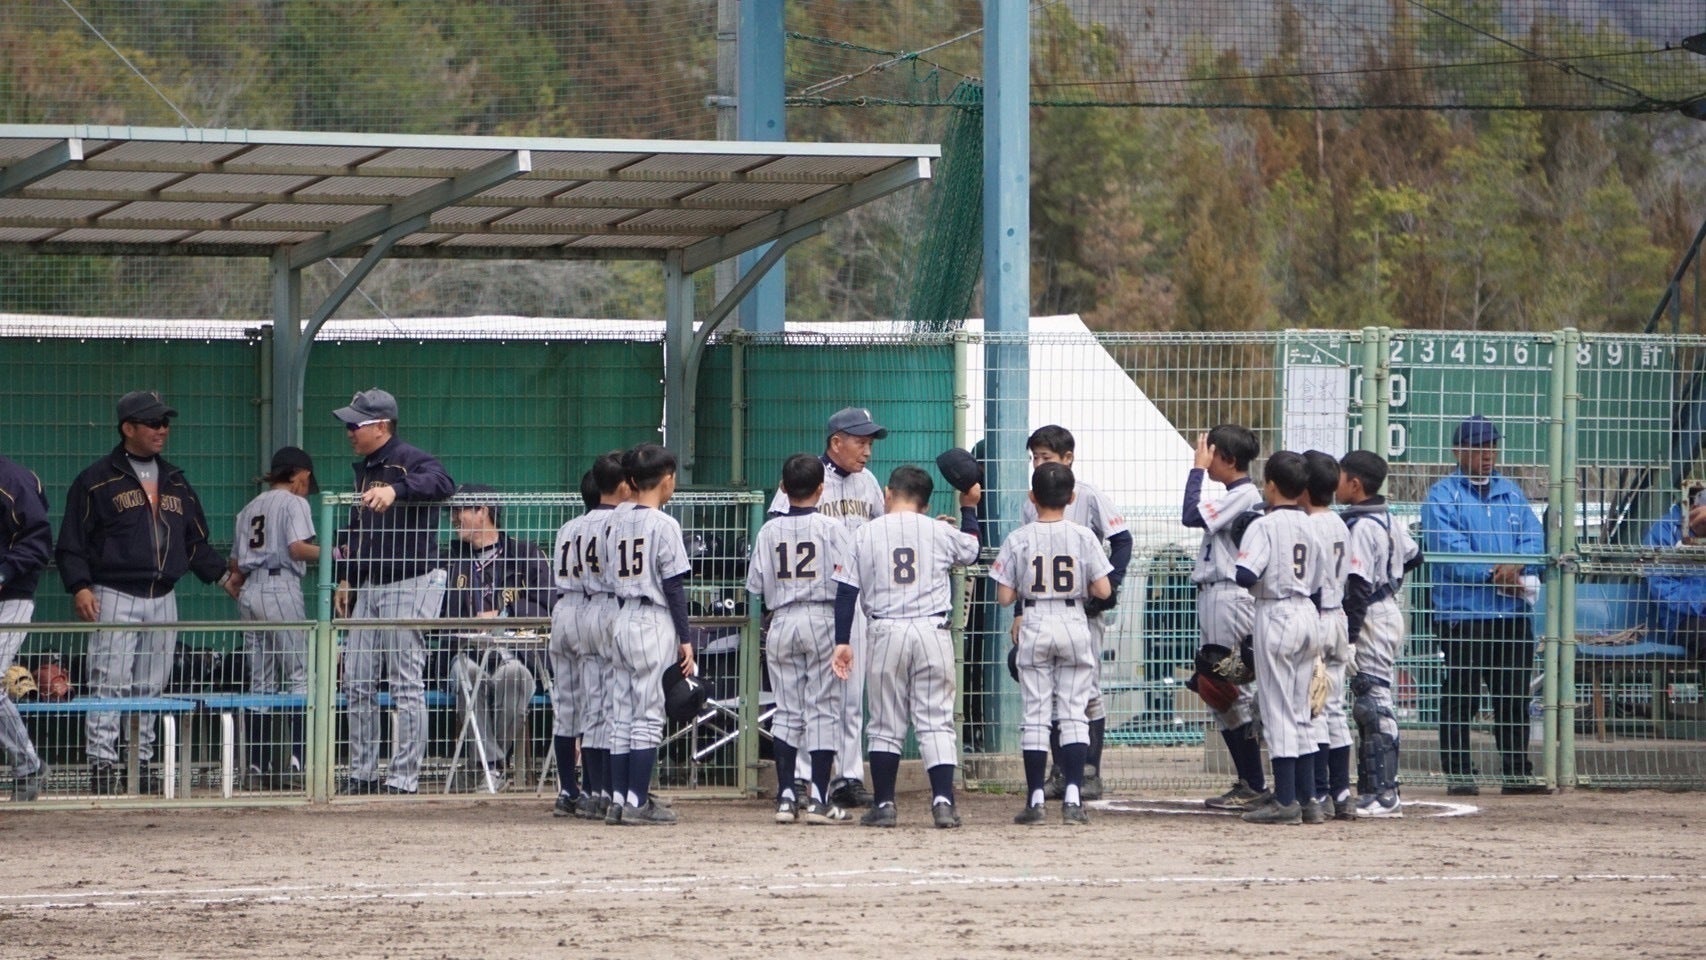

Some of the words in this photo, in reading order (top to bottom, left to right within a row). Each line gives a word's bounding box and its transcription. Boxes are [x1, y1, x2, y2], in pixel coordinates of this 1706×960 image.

[1290, 348, 1322, 364] チーム
[1390, 340, 1404, 362] 2
[1420, 340, 1435, 362] 3
[1451, 340, 1466, 362] 4
[1482, 340, 1497, 363] 5
[1514, 341, 1528, 364] 6
[1576, 343, 1592, 365] 8
[1607, 343, 1622, 366] 9
[1388, 374, 1407, 407] 0
[1388, 423, 1406, 456] 0
[250, 515, 265, 549] 3
[617, 537, 645, 578] 15
[775, 541, 817, 580] 12
[892, 546, 916, 585] 8
[1030, 554, 1075, 594] 16
[1292, 542, 1308, 580] 9
[1332, 540, 1346, 579] 7
